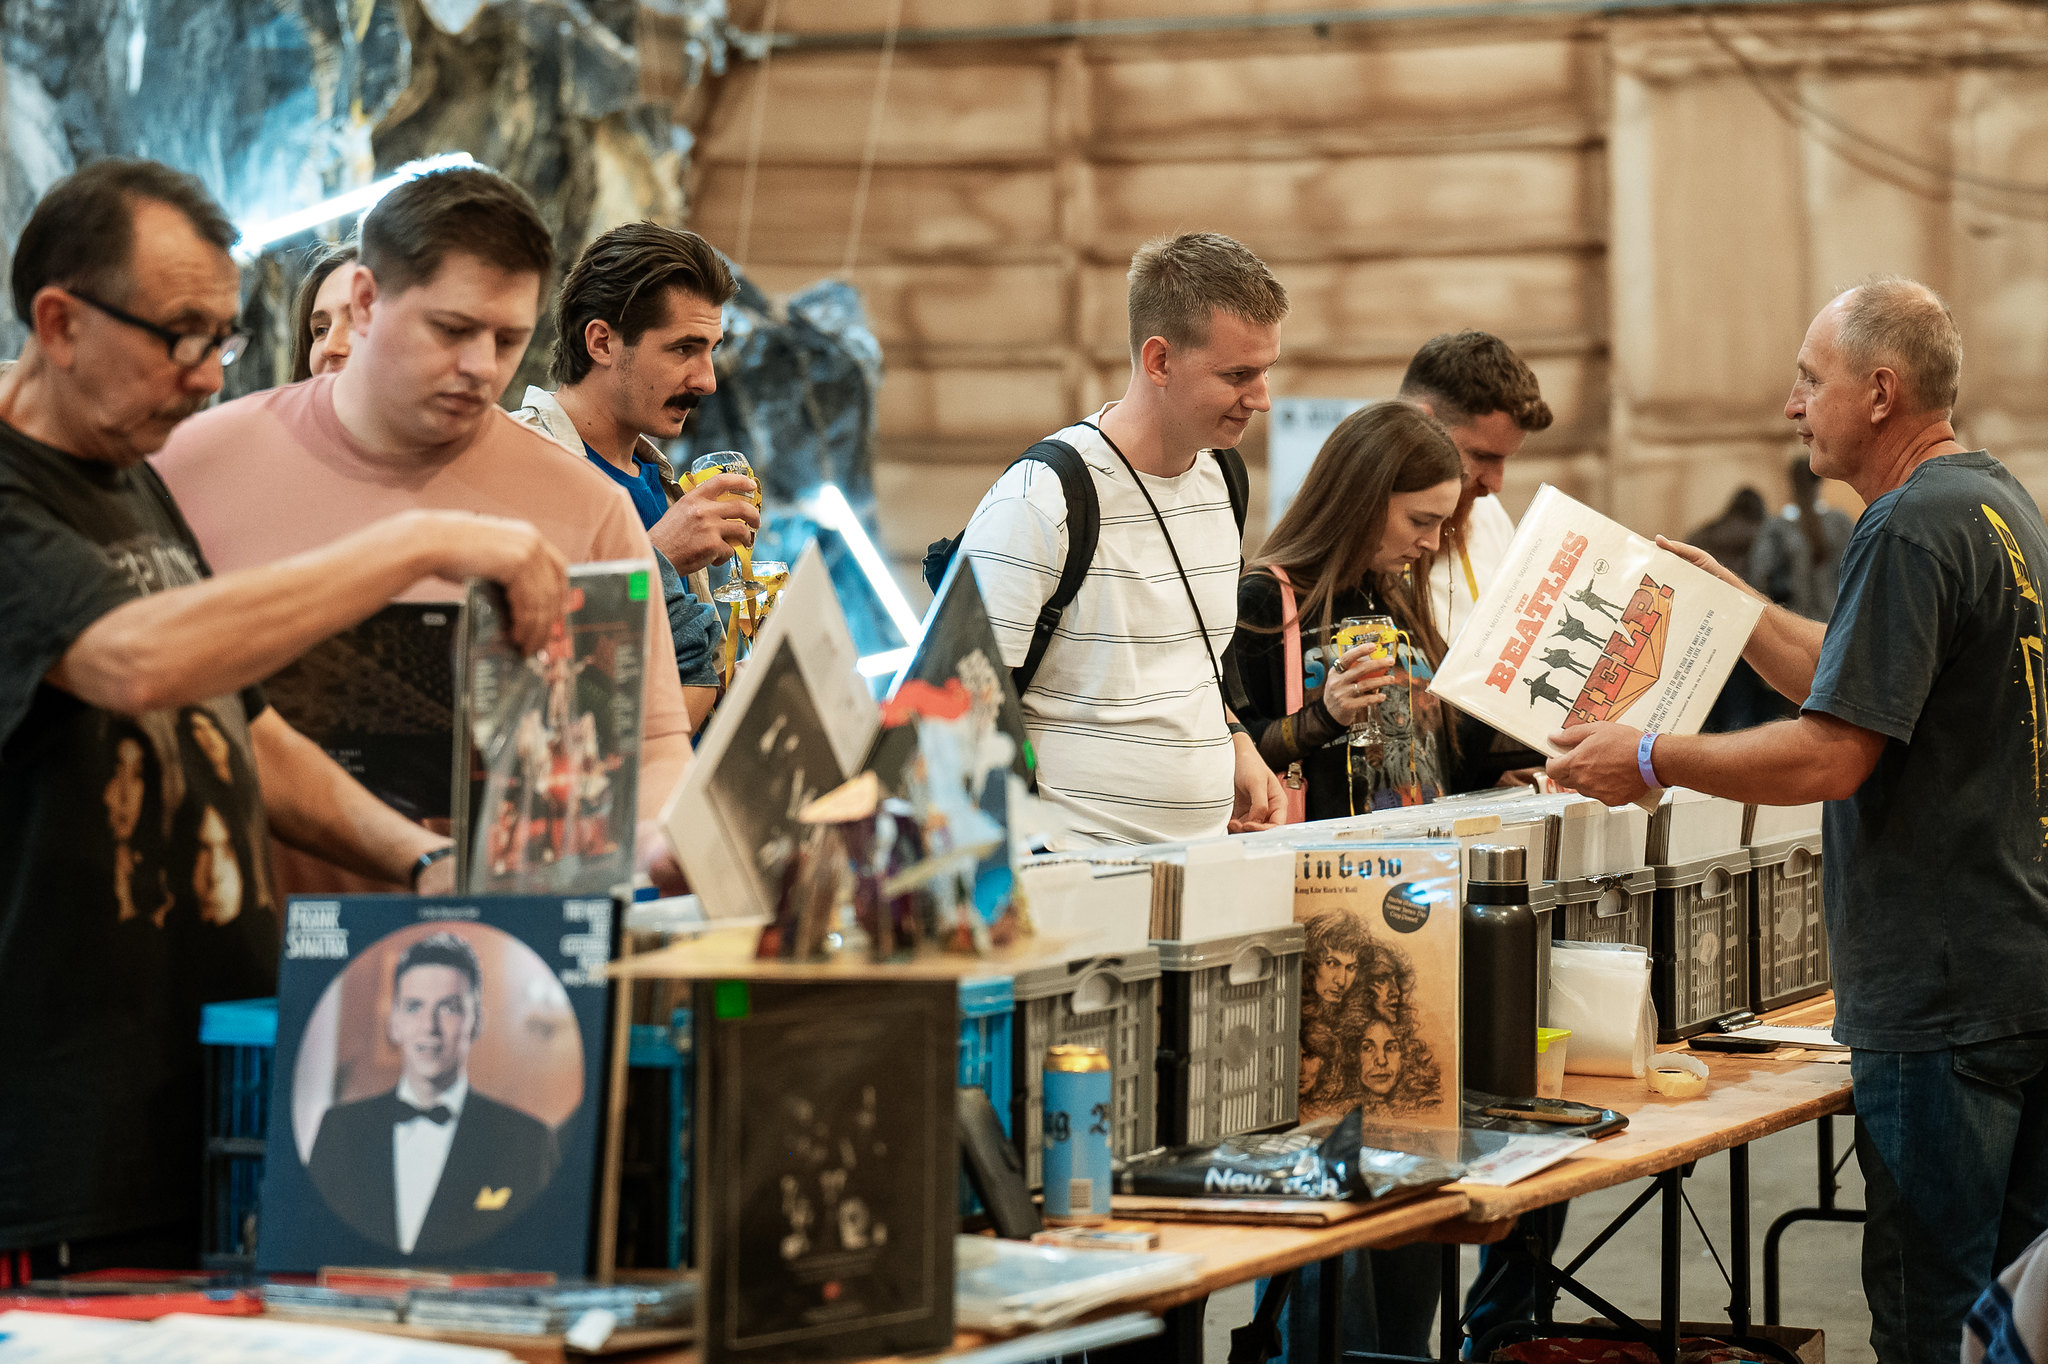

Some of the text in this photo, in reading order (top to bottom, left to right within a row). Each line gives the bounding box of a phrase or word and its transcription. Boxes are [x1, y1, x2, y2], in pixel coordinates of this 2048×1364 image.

[1485, 530, 1589, 694] BEATLES
[1489, 603, 1506, 629] MOTION
[1513, 592, 1529, 614] THE
[1562, 573, 1675, 729] HELP!
[1663, 686, 1672, 696] GOT
[1678, 656, 1688, 669] YOUR
[1685, 645, 1694, 657] LOVE
[1699, 618, 1709, 631] NEED
[1706, 609, 1714, 619] YOU
[1683, 658, 1695, 674] GONNA
[1691, 647, 1701, 658] LOSE
[1698, 636, 1707, 647] THAT
[1703, 625, 1713, 636] GIRL
[1295, 853, 1402, 880] inbow
[1204, 1166, 1272, 1193] New
